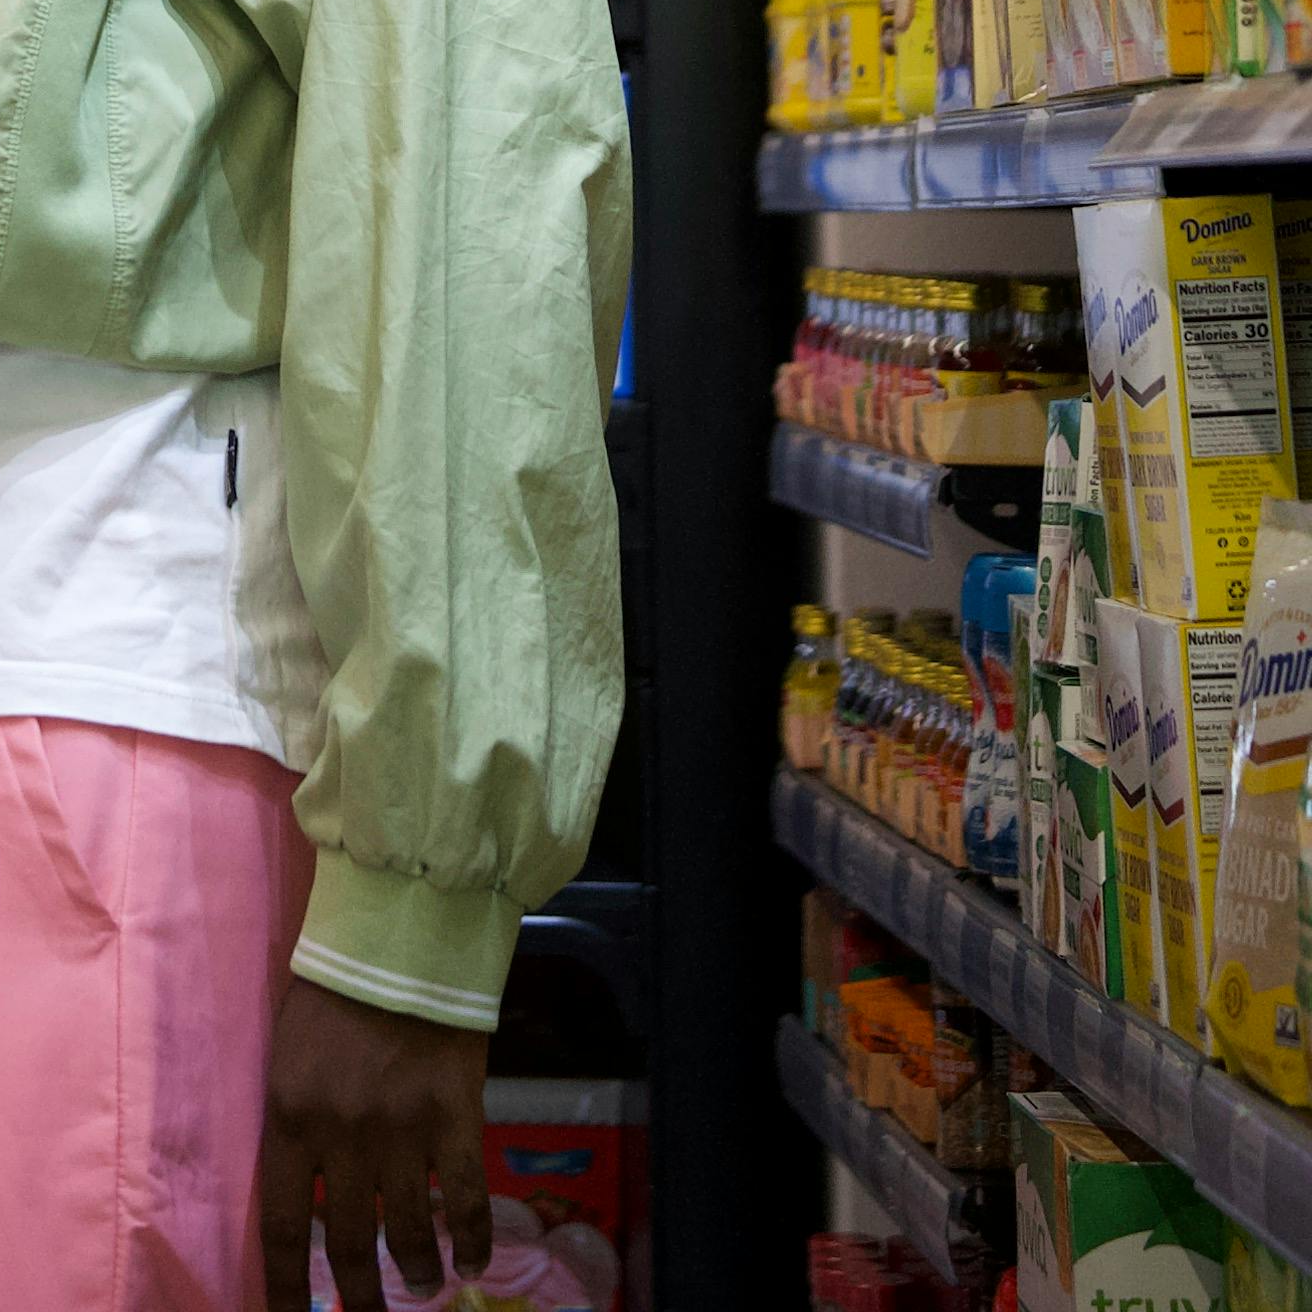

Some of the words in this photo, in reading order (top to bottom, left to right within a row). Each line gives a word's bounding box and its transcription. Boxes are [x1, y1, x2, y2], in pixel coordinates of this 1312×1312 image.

[1180, 211, 1253, 244] Domino
[1179, 281, 1231, 296] Nutrition
[1232, 279, 1266, 293] Facts
[1183, 326, 1239, 342] Calories
[1244, 321, 1269, 339] 30
[1188, 631, 1242, 646] Nutrition
